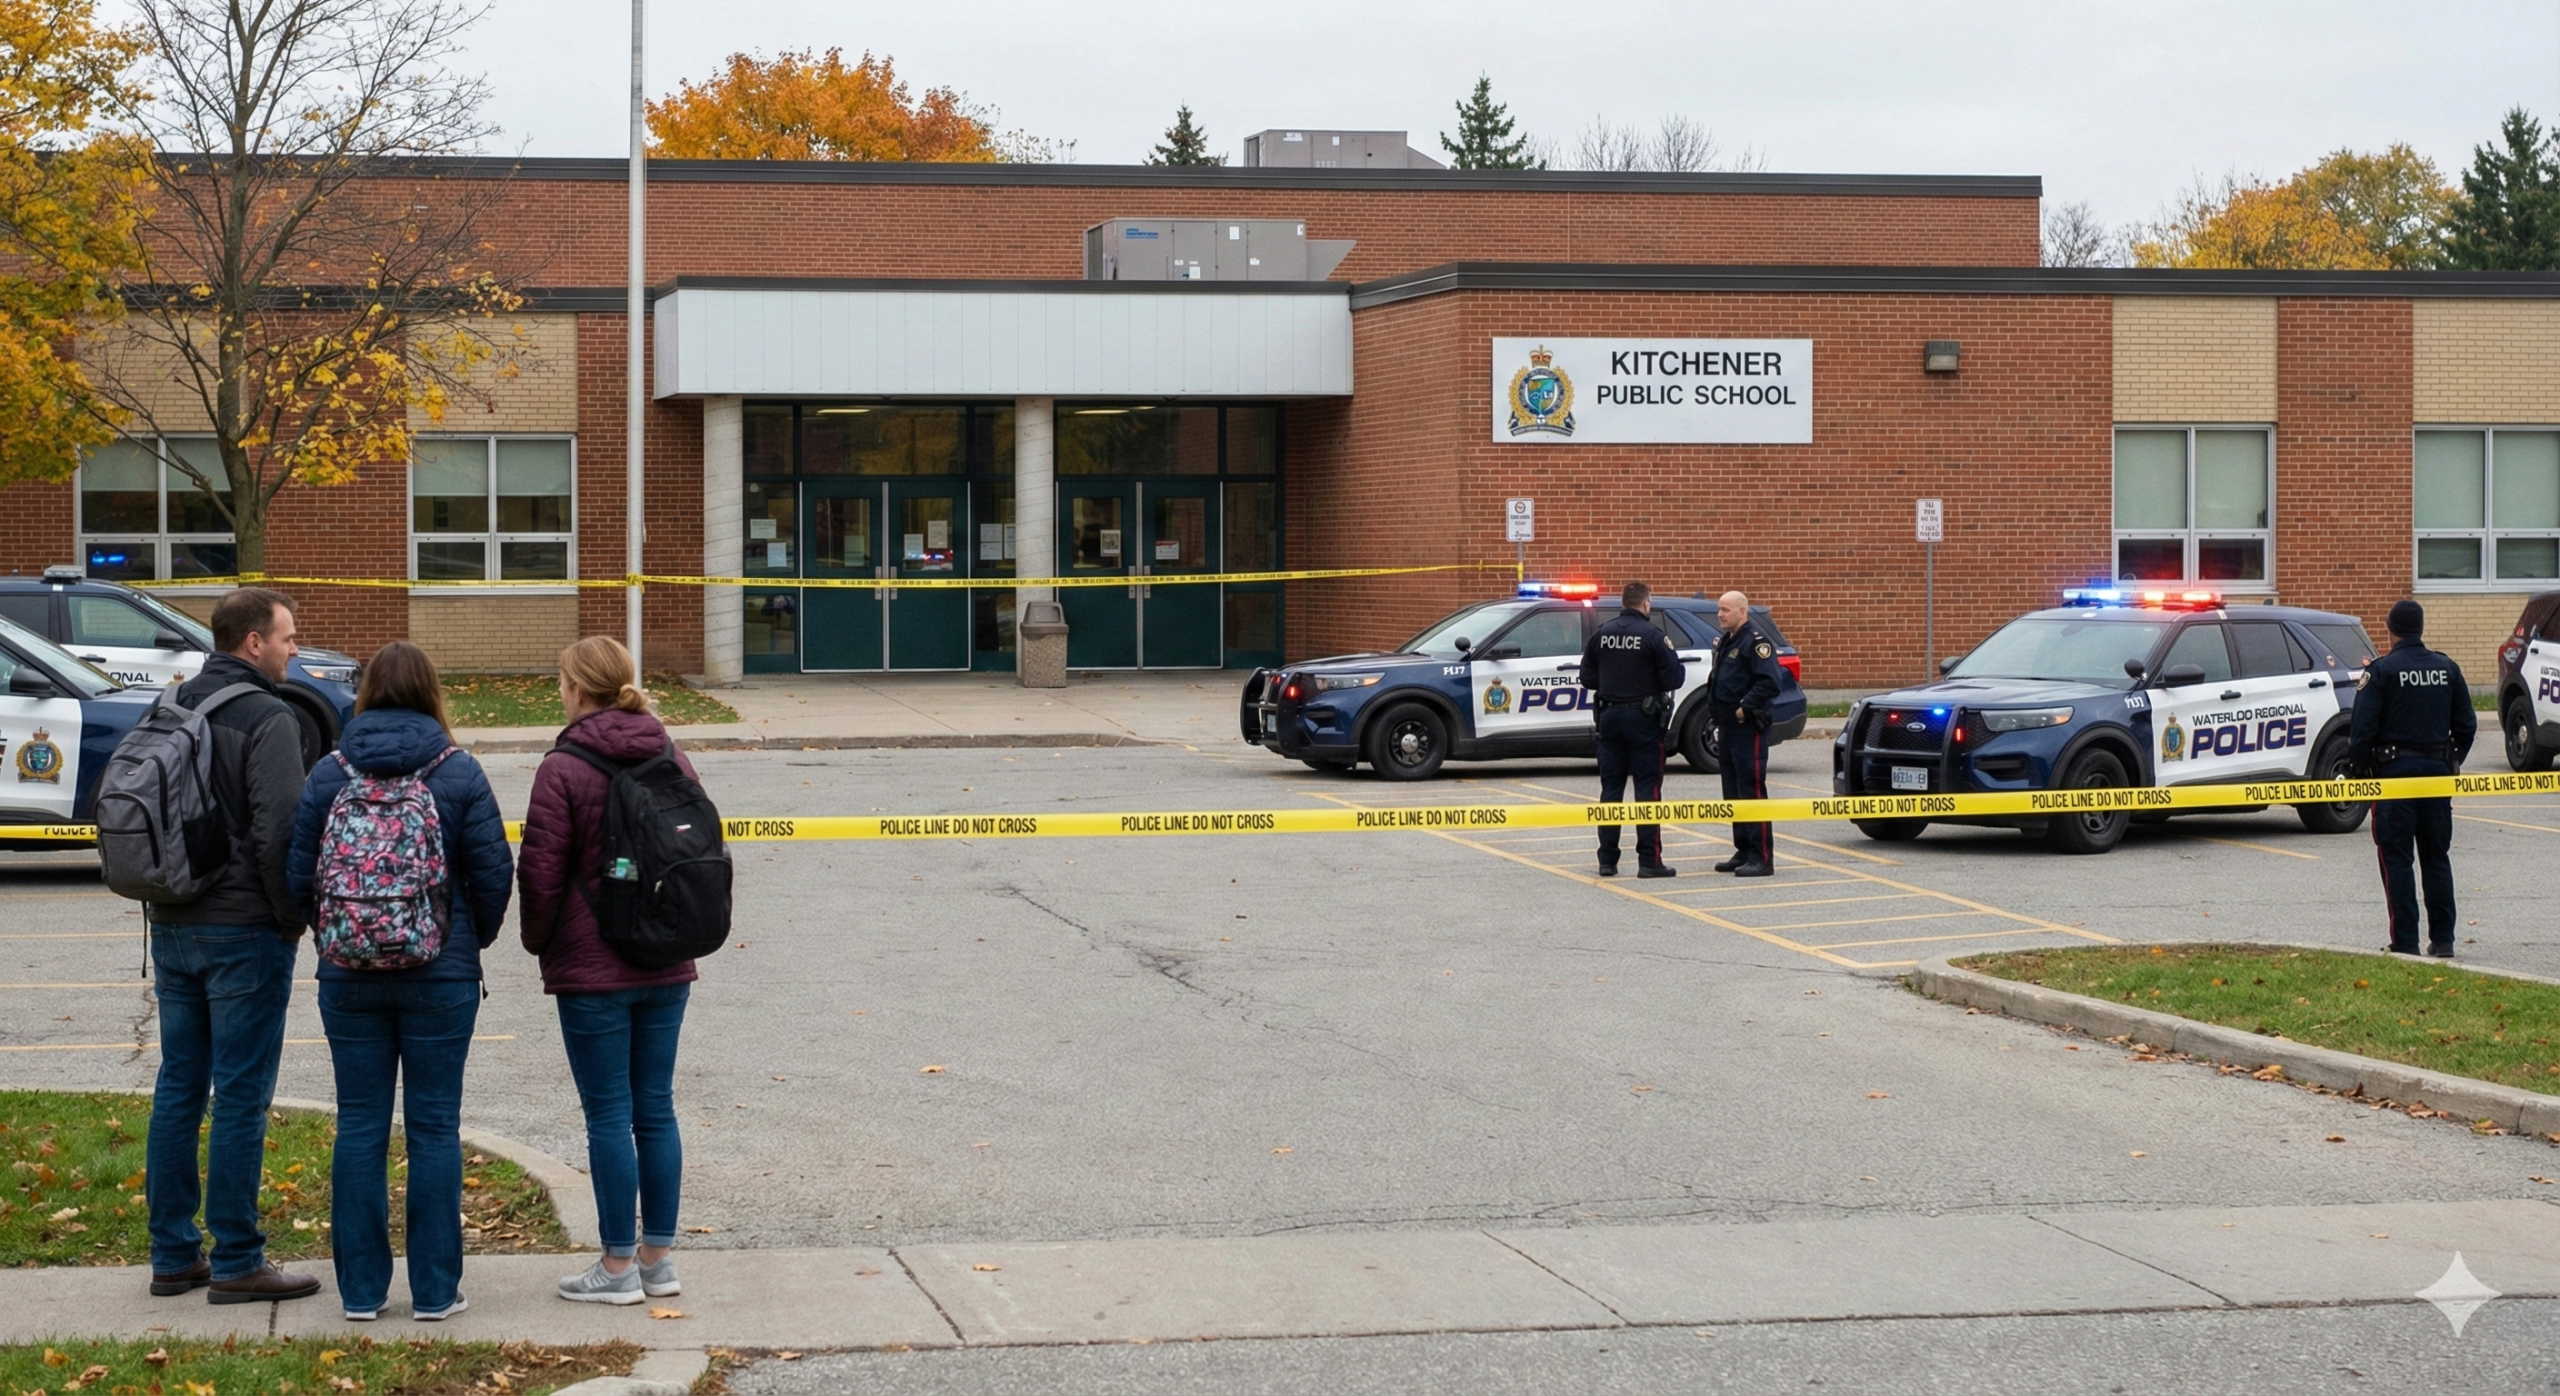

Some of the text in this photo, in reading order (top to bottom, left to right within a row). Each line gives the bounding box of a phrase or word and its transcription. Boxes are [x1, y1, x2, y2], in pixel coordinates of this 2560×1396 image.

[1611, 350, 1782, 376] KITCHENER
[1596, 384, 1796, 406] PUBLIC SCHOOL
[1600, 634, 1642, 650] POLICE
[2398, 670, 2448, 688] POLICE
[1518, 687, 1595, 713] POL
[2254, 702, 2307, 721] REGIONAL
[2190, 716, 2308, 760] POLICE
[2245, 781, 2382, 801] POLICE LINE DO NOT CROSS
[2454, 777, 2491, 793] POLICE
[2493, 777, 2516, 790] LINE
[2518, 776, 2533, 789] DO
[2534, 775, 2554, 789] NOT
[1812, 796, 1956, 816] POLICE LINE DO NOT CROSS
[2031, 789, 2172, 809] POLICE LINE DO NOT CROSS
[1357, 810, 1507, 826] POLICE LINE DO NOT CROSS
[1587, 803, 1734, 822] POLICE LINE DO NOT CROSS
[727, 821, 794, 836] NOT CROSS
[880, 818, 1037, 834] POLICE LINE DO NOT CROSS
[1121, 814, 1274, 831] POLICE LINE DO NOT CROSS
